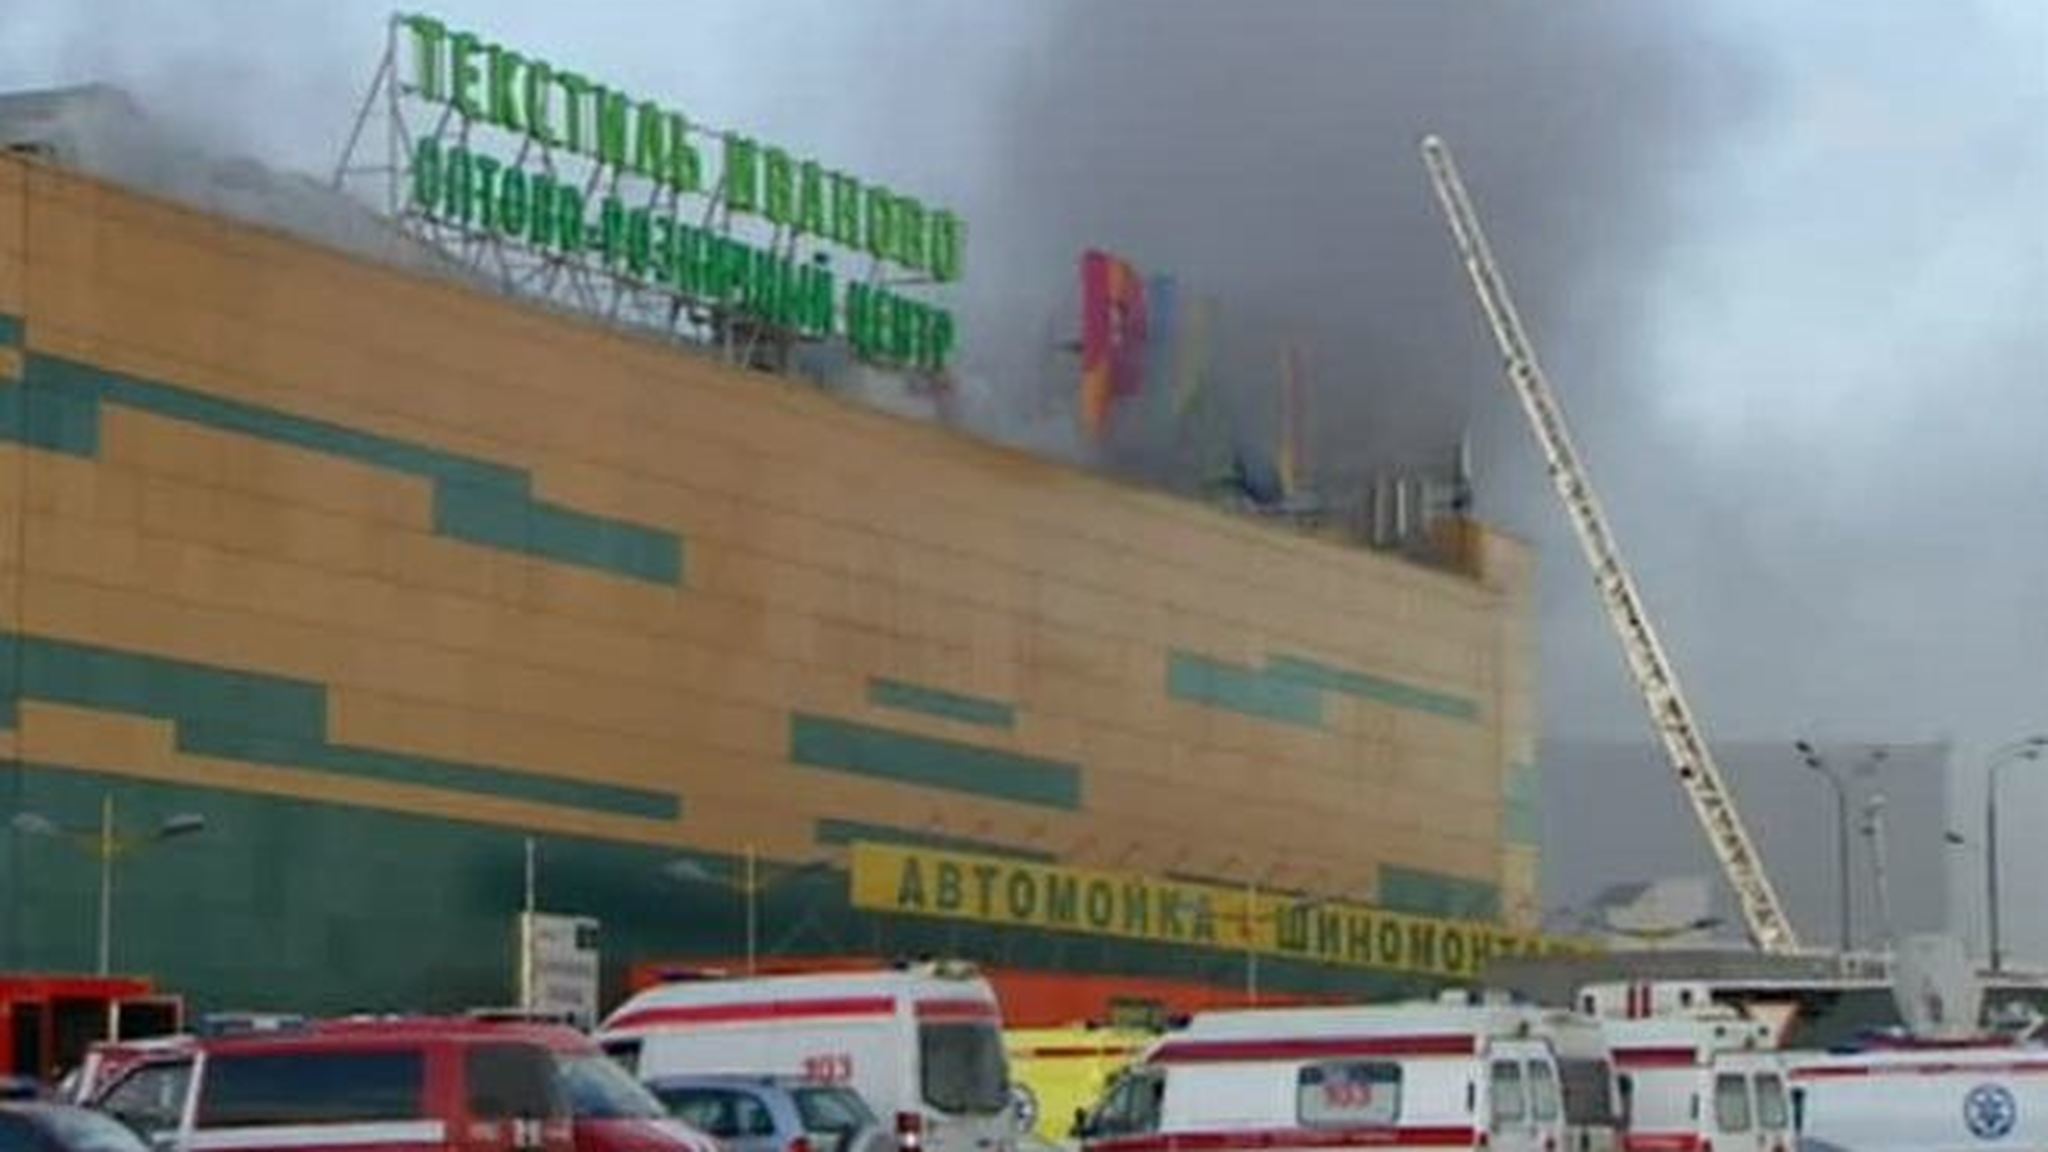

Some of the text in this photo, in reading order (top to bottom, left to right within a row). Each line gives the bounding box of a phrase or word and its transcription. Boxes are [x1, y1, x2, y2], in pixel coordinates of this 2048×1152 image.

[409, 15, 966, 284] ТЕКСТИЛЬ ИВАНОВО
[848, 280, 956, 370] ЦЕНТР
[897, 855, 1216, 941] АВТОМОЙКА
